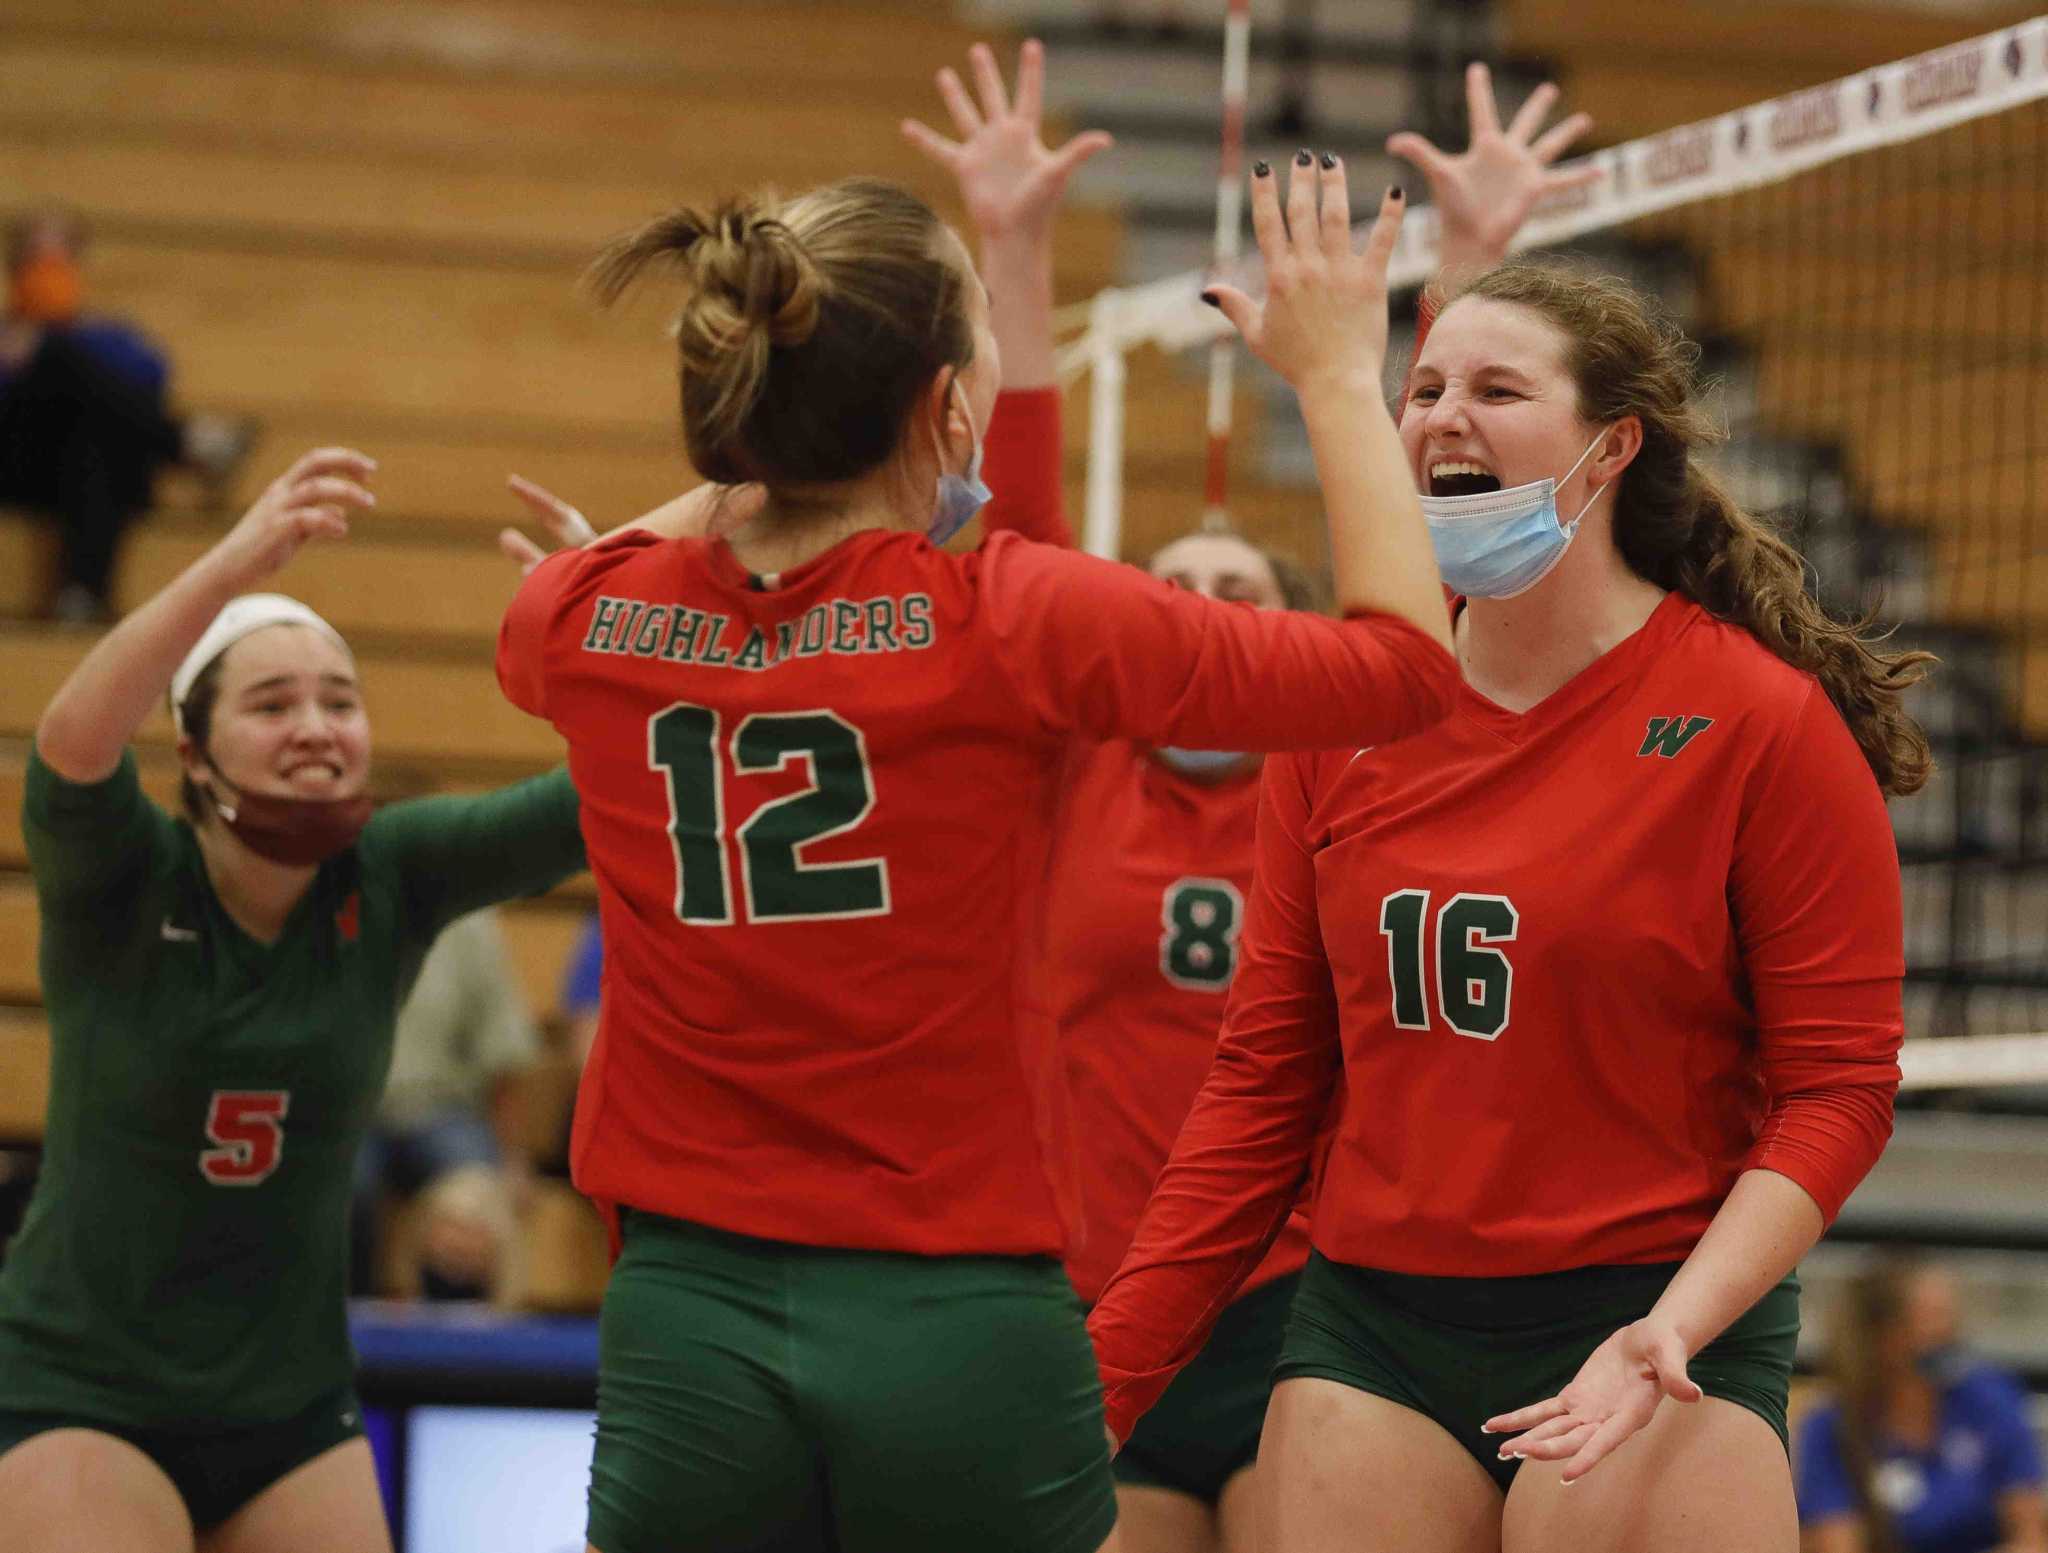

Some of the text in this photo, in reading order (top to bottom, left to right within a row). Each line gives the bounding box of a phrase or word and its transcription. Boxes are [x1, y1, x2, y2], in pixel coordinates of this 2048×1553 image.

[583, 593, 935, 671] HIGHLANDERS
[1636, 715, 1714, 759] W
[648, 701, 891, 926] 12
[1160, 878, 1244, 992] 8
[1379, 888, 1519, 1041] 16
[200, 1091, 289, 1186] 5
